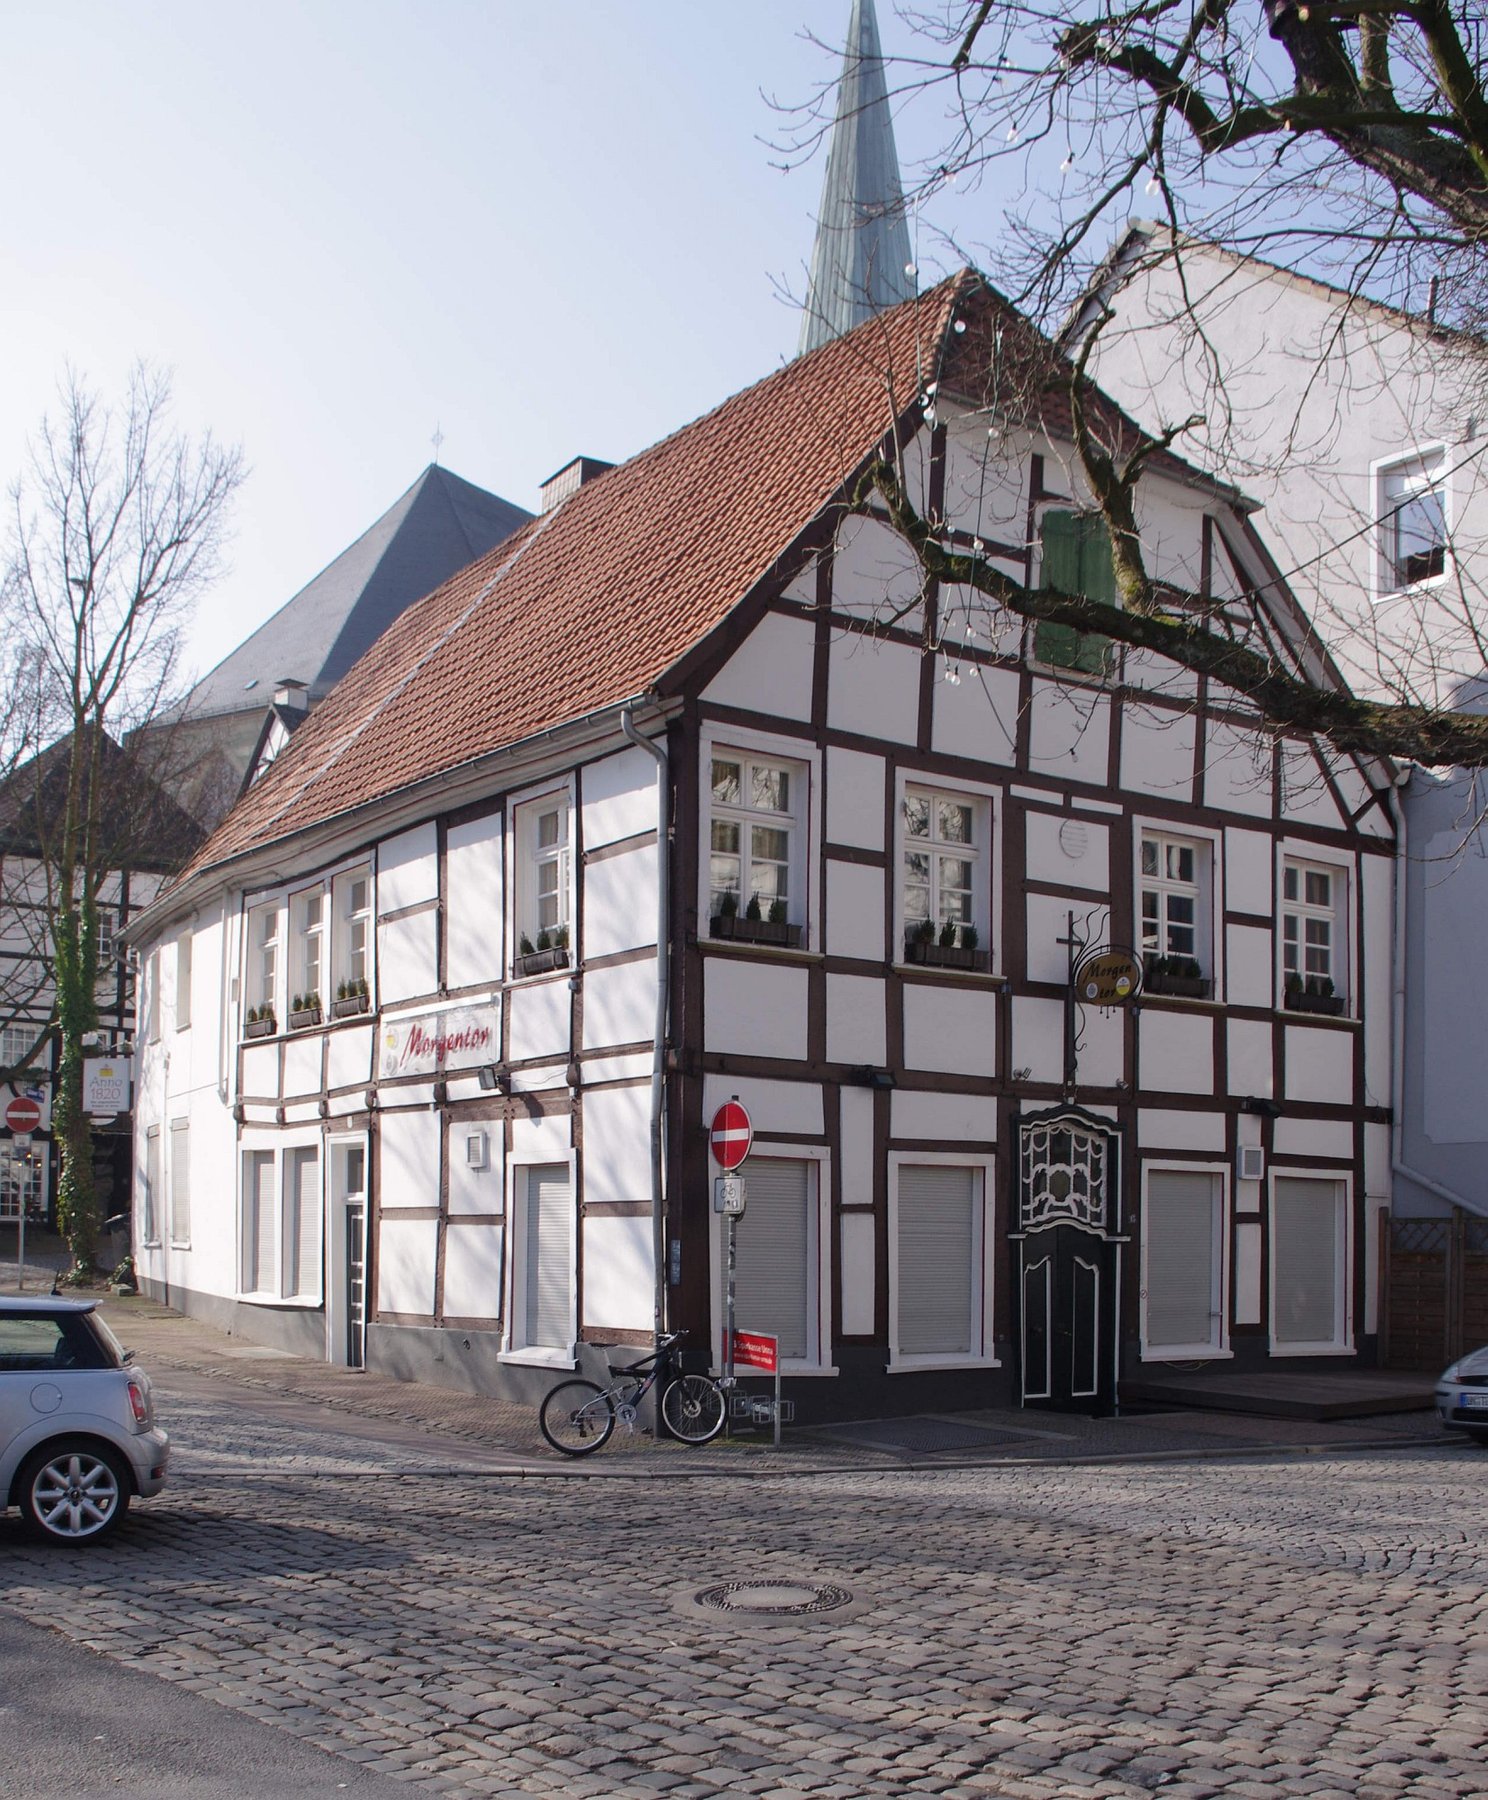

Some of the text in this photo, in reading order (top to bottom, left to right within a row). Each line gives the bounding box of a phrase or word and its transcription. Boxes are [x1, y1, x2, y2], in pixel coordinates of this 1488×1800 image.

[1083, 962, 1132, 984] Morgen
[1099, 986, 1117, 999] tor
[399, 1023, 491, 1067] Morgentor
[89, 1076, 123, 1088] Anno
[91, 1088, 121, 1100] 1820
